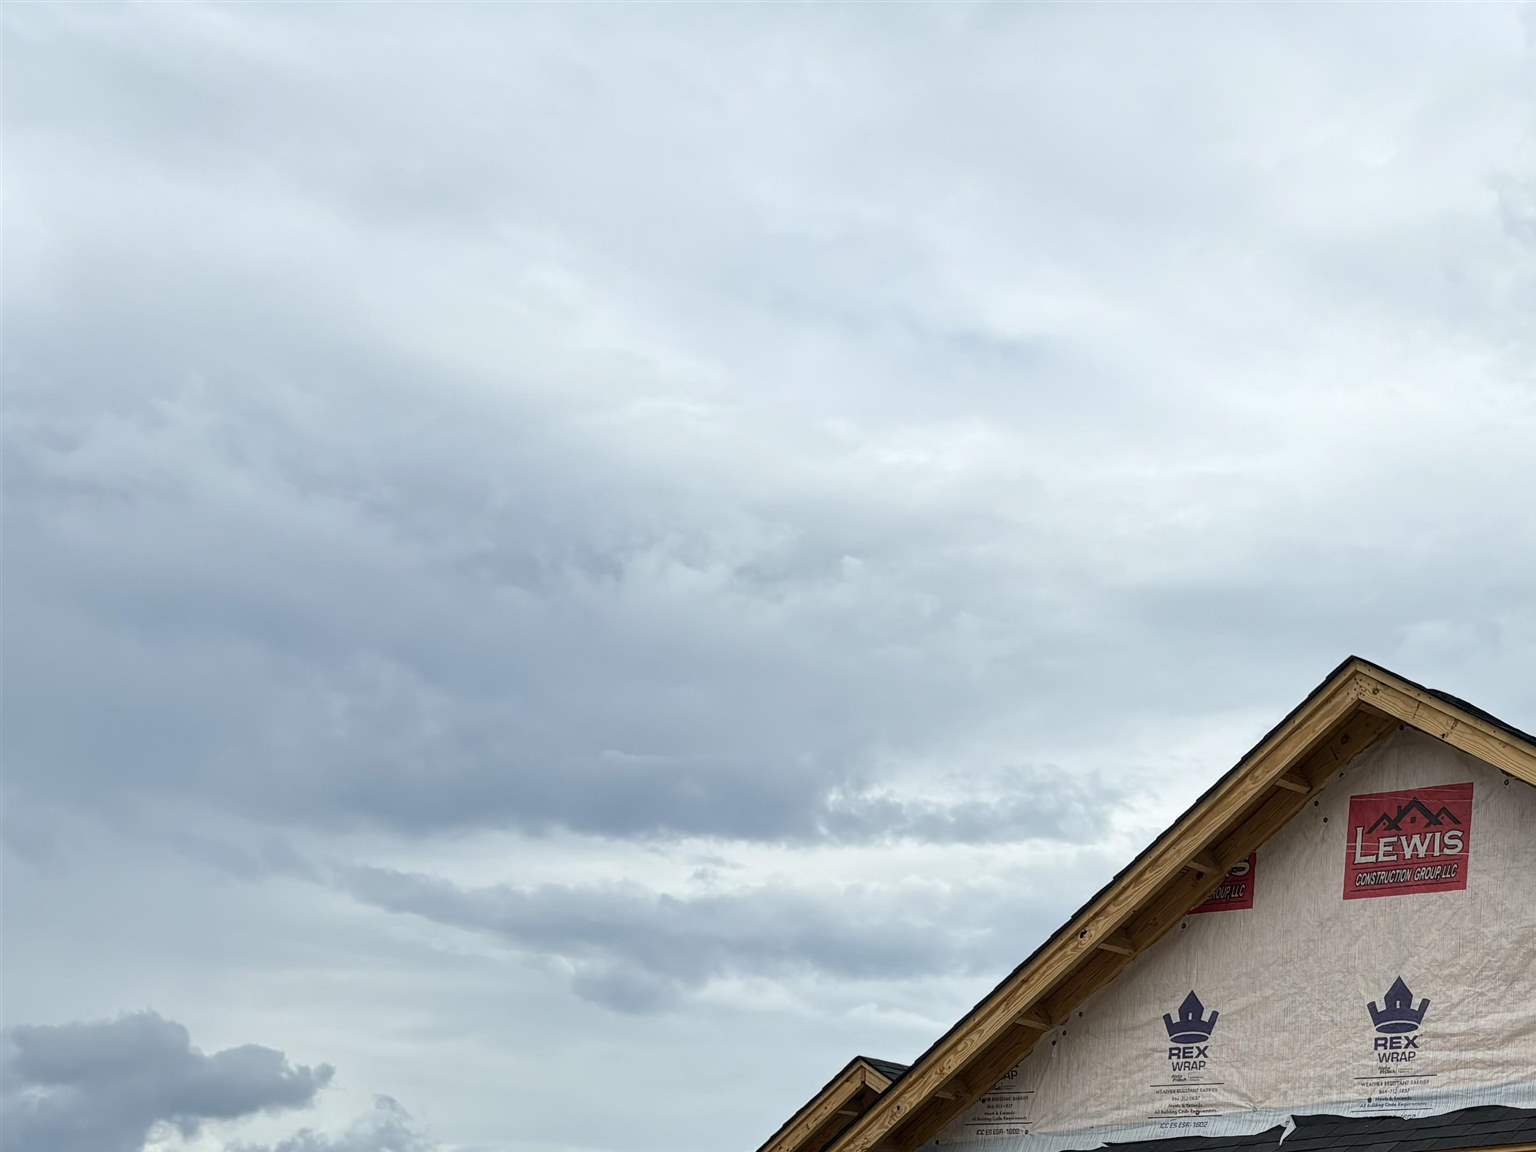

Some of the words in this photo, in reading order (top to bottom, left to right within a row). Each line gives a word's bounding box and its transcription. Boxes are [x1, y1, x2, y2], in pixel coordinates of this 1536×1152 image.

[1354, 826, 1464, 865] LEWIS
[1355, 867, 1411, 886] CONSTRUCTION
[1374, 1035, 1419, 1051] REX
[1168, 1045, 1209, 1060] REX
[1378, 1051, 1416, 1063] WRAP
[1171, 1060, 1206, 1072] WRAP
